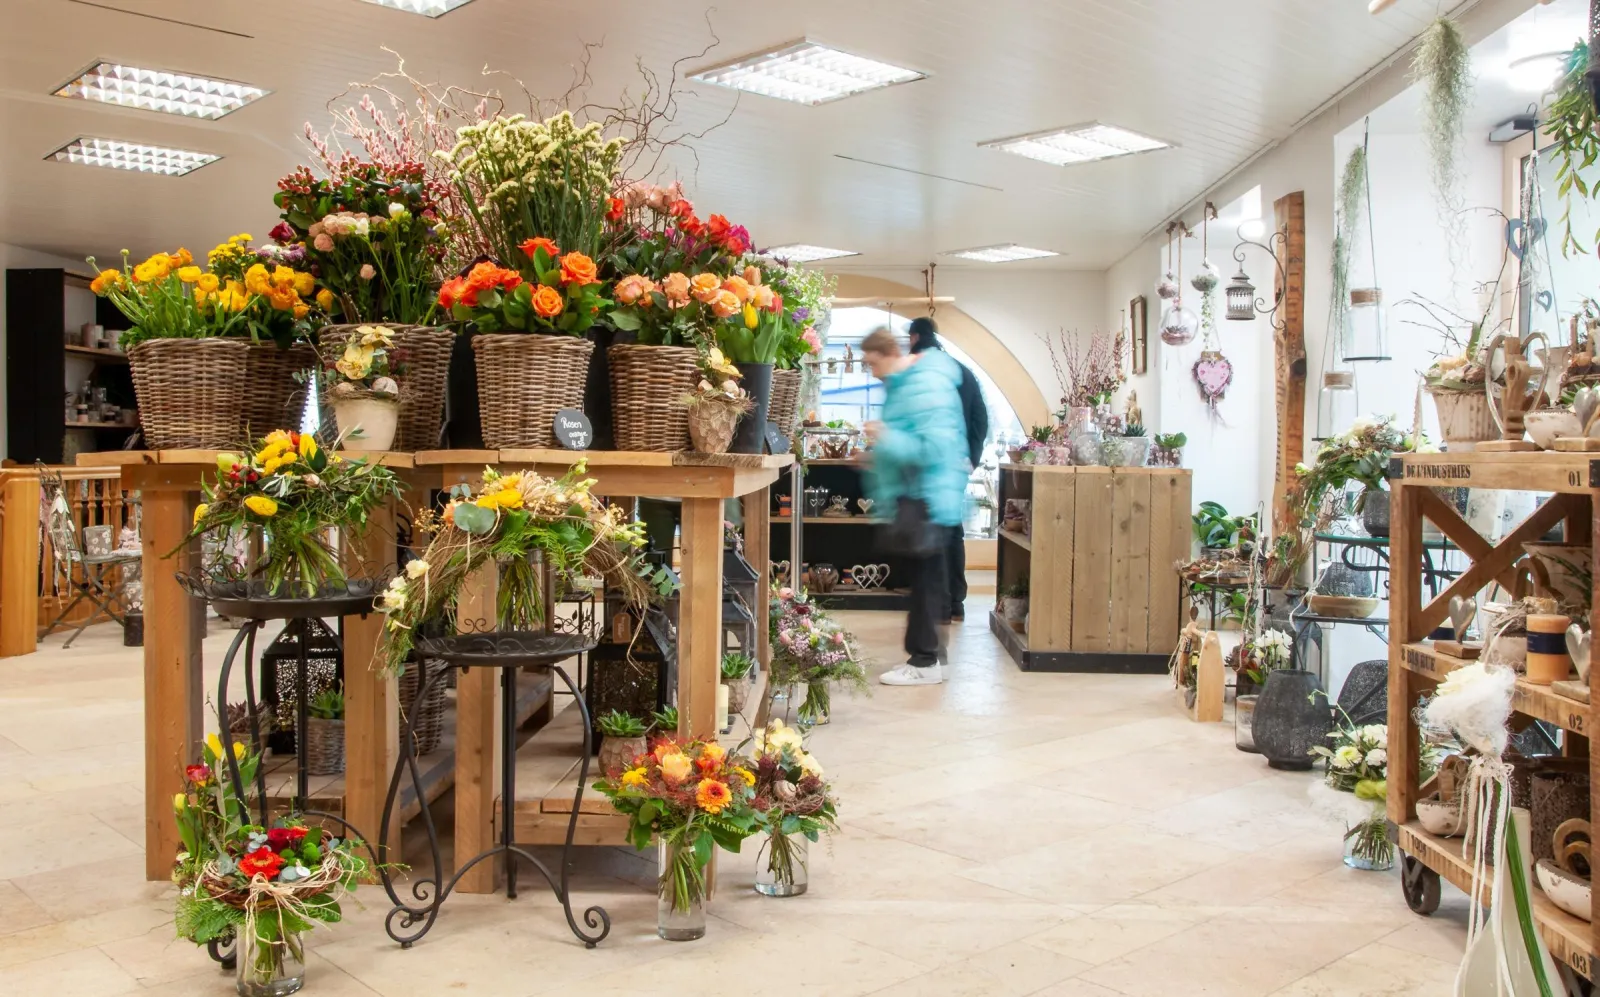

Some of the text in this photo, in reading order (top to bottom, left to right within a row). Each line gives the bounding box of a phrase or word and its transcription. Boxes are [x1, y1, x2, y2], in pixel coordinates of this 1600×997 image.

[560, 416, 583, 429] Rosen
[1406, 464, 1471, 479] DE L'INDUSTRIES
[1568, 470, 1581, 487] 01
[1568, 713, 1582, 731] 02
[1572, 951, 1587, 974] 03
